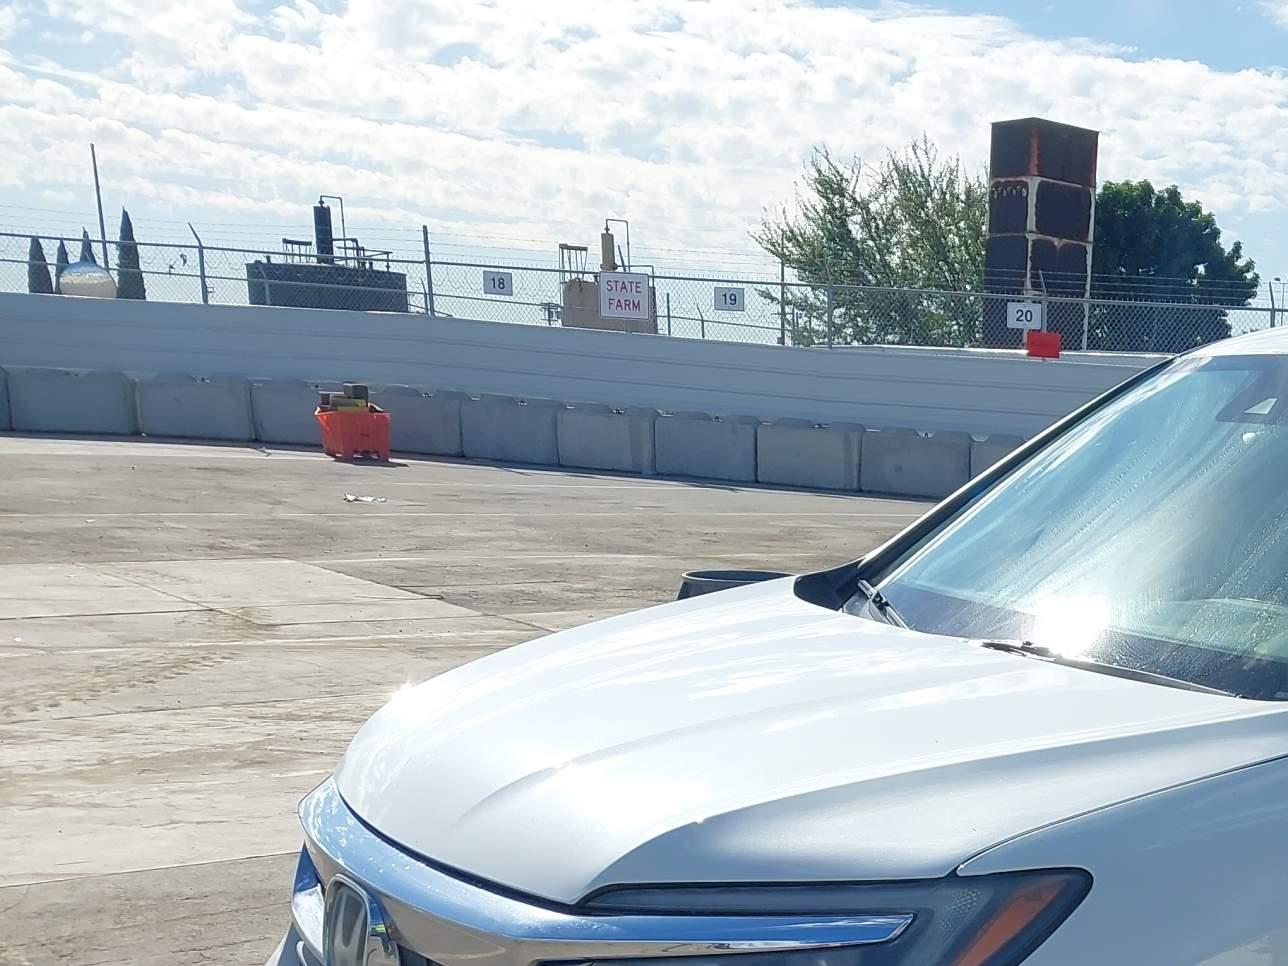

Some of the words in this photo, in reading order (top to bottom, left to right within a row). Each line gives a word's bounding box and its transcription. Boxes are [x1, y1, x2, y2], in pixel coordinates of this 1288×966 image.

[490, 276, 505, 290] 18
[606, 280, 642, 293] STATE
[608, 298, 640, 312] FARM
[721, 292, 737, 305] 19
[1015, 309, 1033, 323] 20
